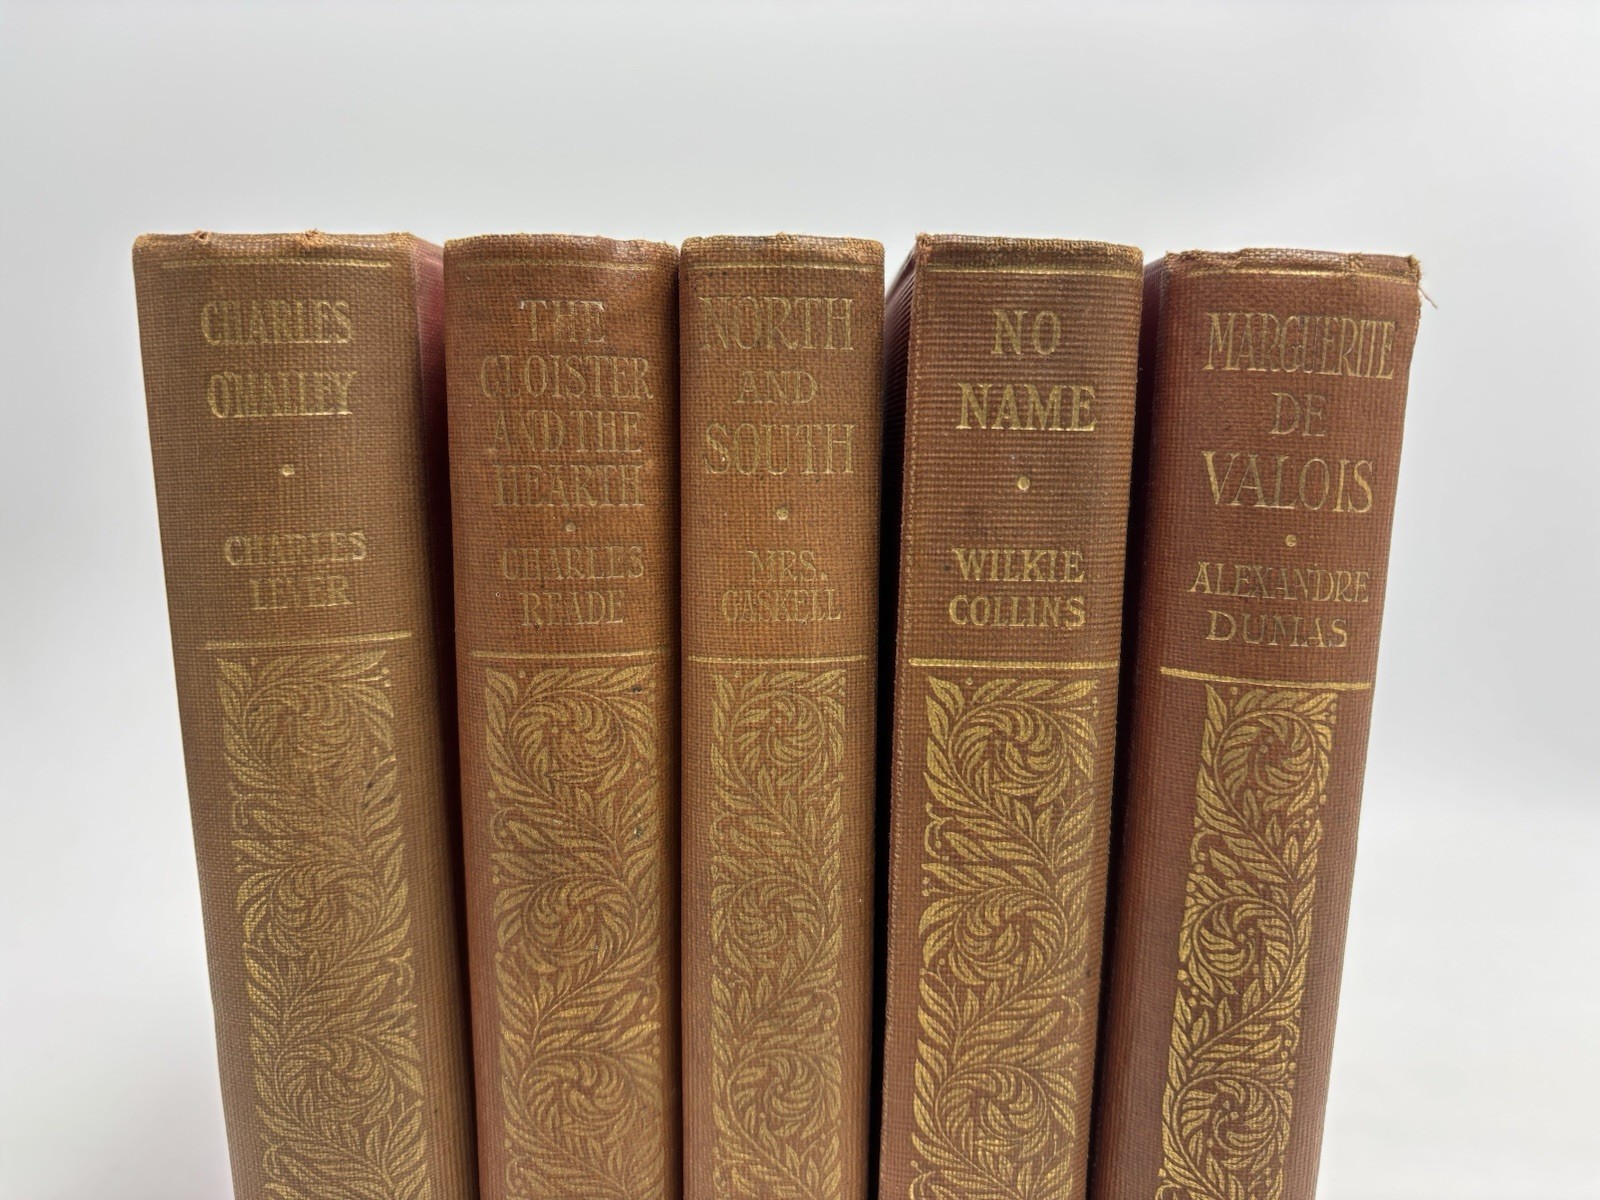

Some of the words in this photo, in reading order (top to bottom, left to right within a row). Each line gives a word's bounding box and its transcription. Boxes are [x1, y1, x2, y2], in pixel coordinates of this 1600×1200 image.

[201, 299, 354, 346] CHARLES
[520, 299, 606, 343] THE
[699, 297, 854, 351] NORTH
[990, 308, 1063, 356] NO
[1202, 310, 1396, 381] MARGUERITE
[479, 354, 654, 400] CLOISTER
[733, 370, 818, 405] AND
[955, 381, 1098, 432] NAME
[1267, 391, 1327, 438] DE
[490, 409, 564, 454] AND
[570, 410, 645, 454] THE
[704, 422, 856, 476] SOUTH
[493, 463, 645, 507] HEARTH
[1202, 450, 1374, 513] VALOIS
[223, 530, 367, 566] CHARLES
[502, 545, 645, 580] CHARLES
[747, 549, 828, 583] MRS.
[952, 547, 1086, 583] WILKIE
[1188, 560, 1370, 603] ALEXANDRE
[519, 590, 626, 627] READE
[720, 588, 843, 623] GASKELL
[948, 594, 1087, 629] COLLINS
[1206, 609, 1350, 648] DUMAS
